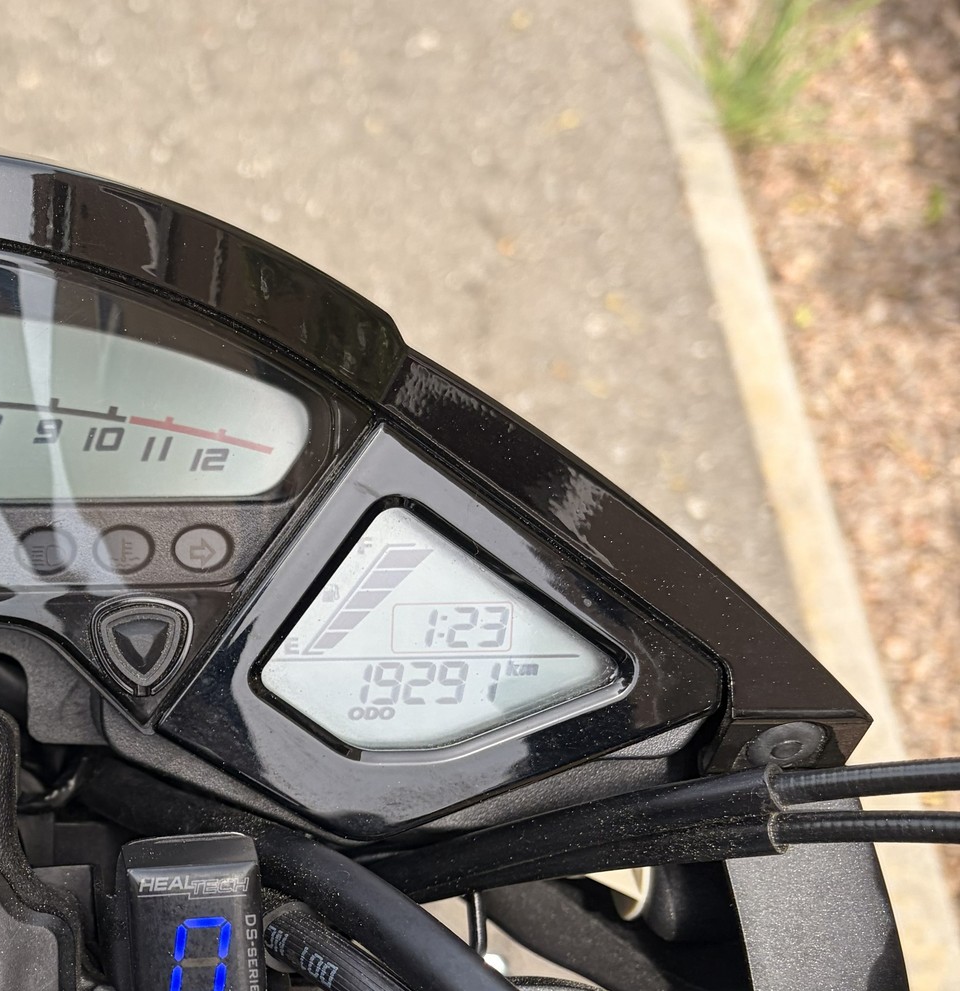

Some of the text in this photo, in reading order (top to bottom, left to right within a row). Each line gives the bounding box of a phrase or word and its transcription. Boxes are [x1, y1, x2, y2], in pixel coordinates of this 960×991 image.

[33, 419, 63, 444] 9
[83, 427, 127, 451] 10
[141, 436, 173, 462] 11
[190, 448, 230, 472] 12
[424, 606, 509, 648] 1:23
[360, 660, 539, 705] 19291 km
[347, 707, 396, 721] ODO
